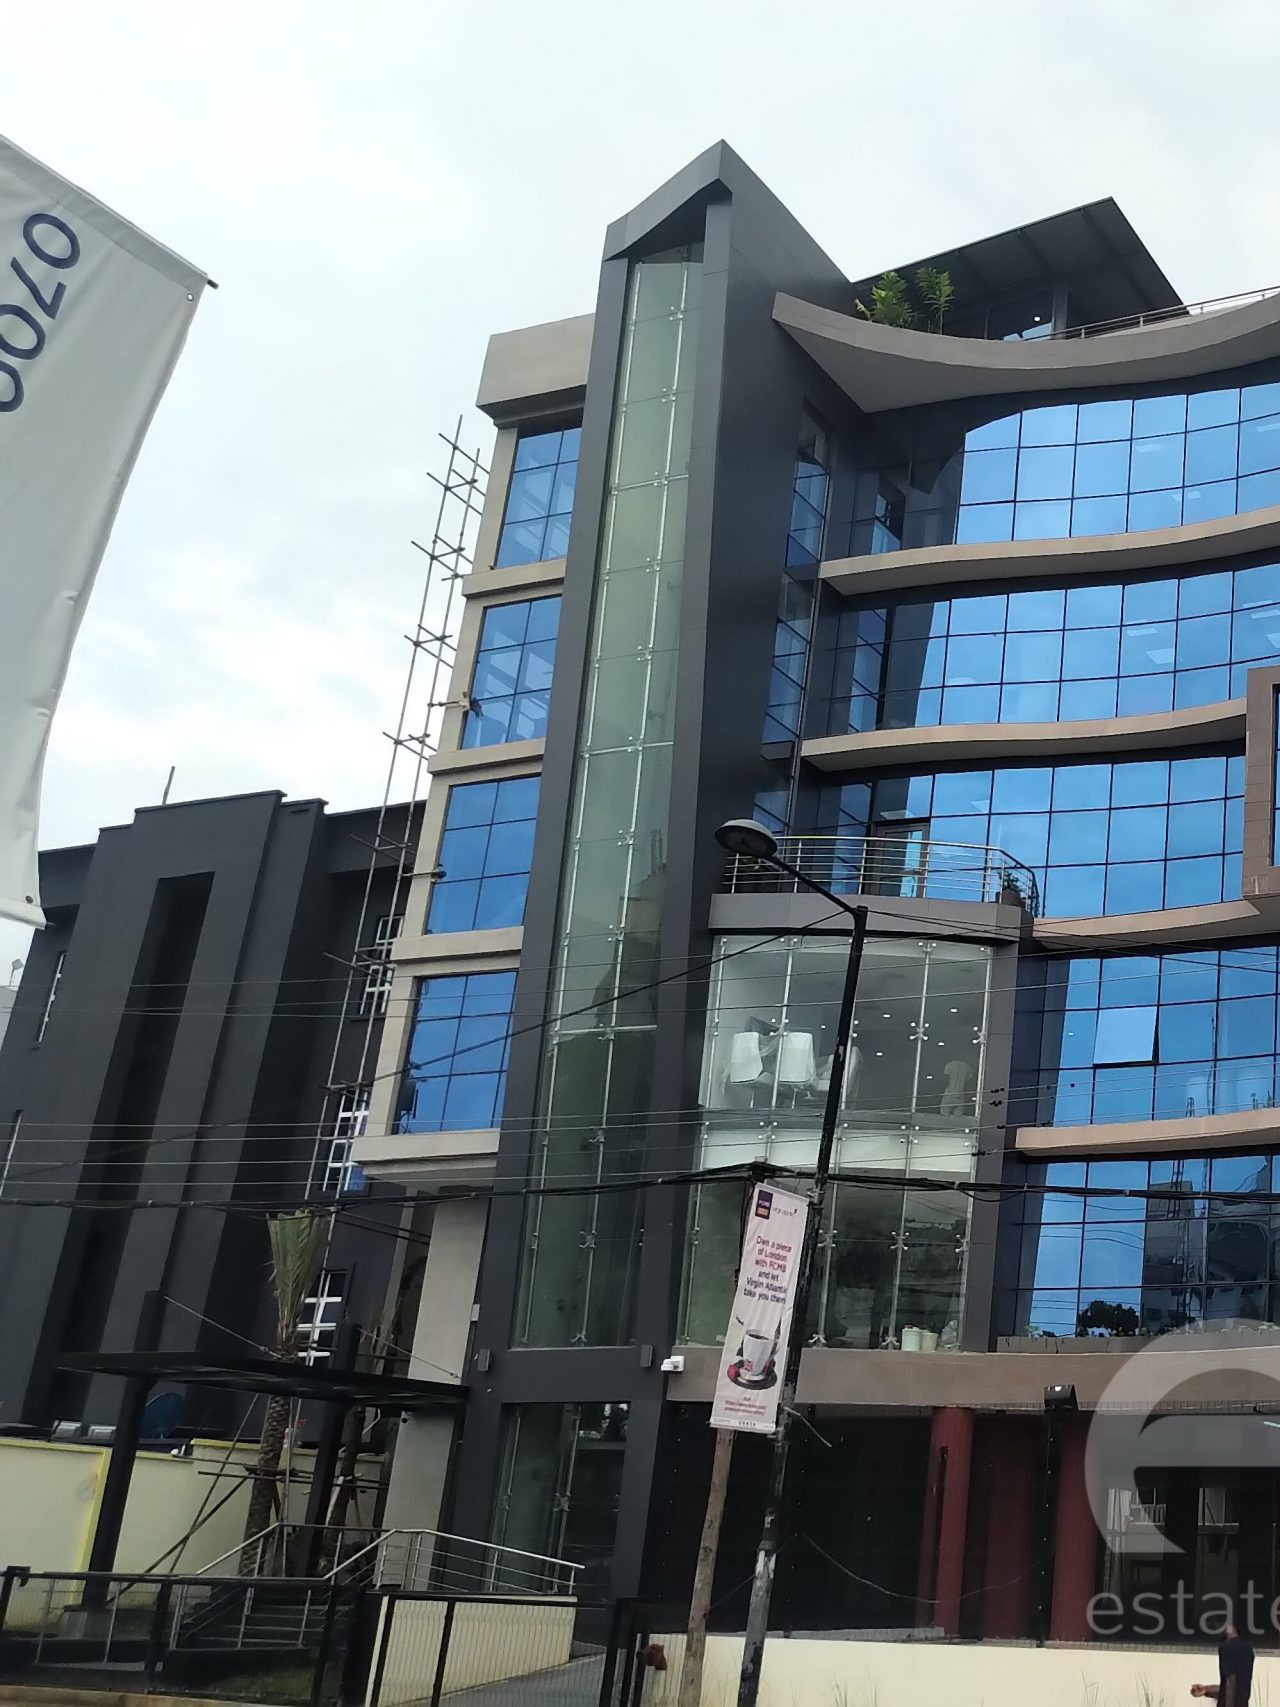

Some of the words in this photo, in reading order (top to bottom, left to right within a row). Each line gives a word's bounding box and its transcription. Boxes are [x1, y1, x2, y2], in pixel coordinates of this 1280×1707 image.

[757, 1236, 770, 1247] Own
[776, 1242, 793, 1253] piece
[765, 1249, 788, 1262] London
[755, 1260, 768, 1268] with
[770, 1261, 787, 1273] FCMB
[758, 1272, 771, 1280] and
[747, 1277, 764, 1290] Virgin
[744, 1288, 757, 1298] take
[758, 1293, 770, 1302] you
